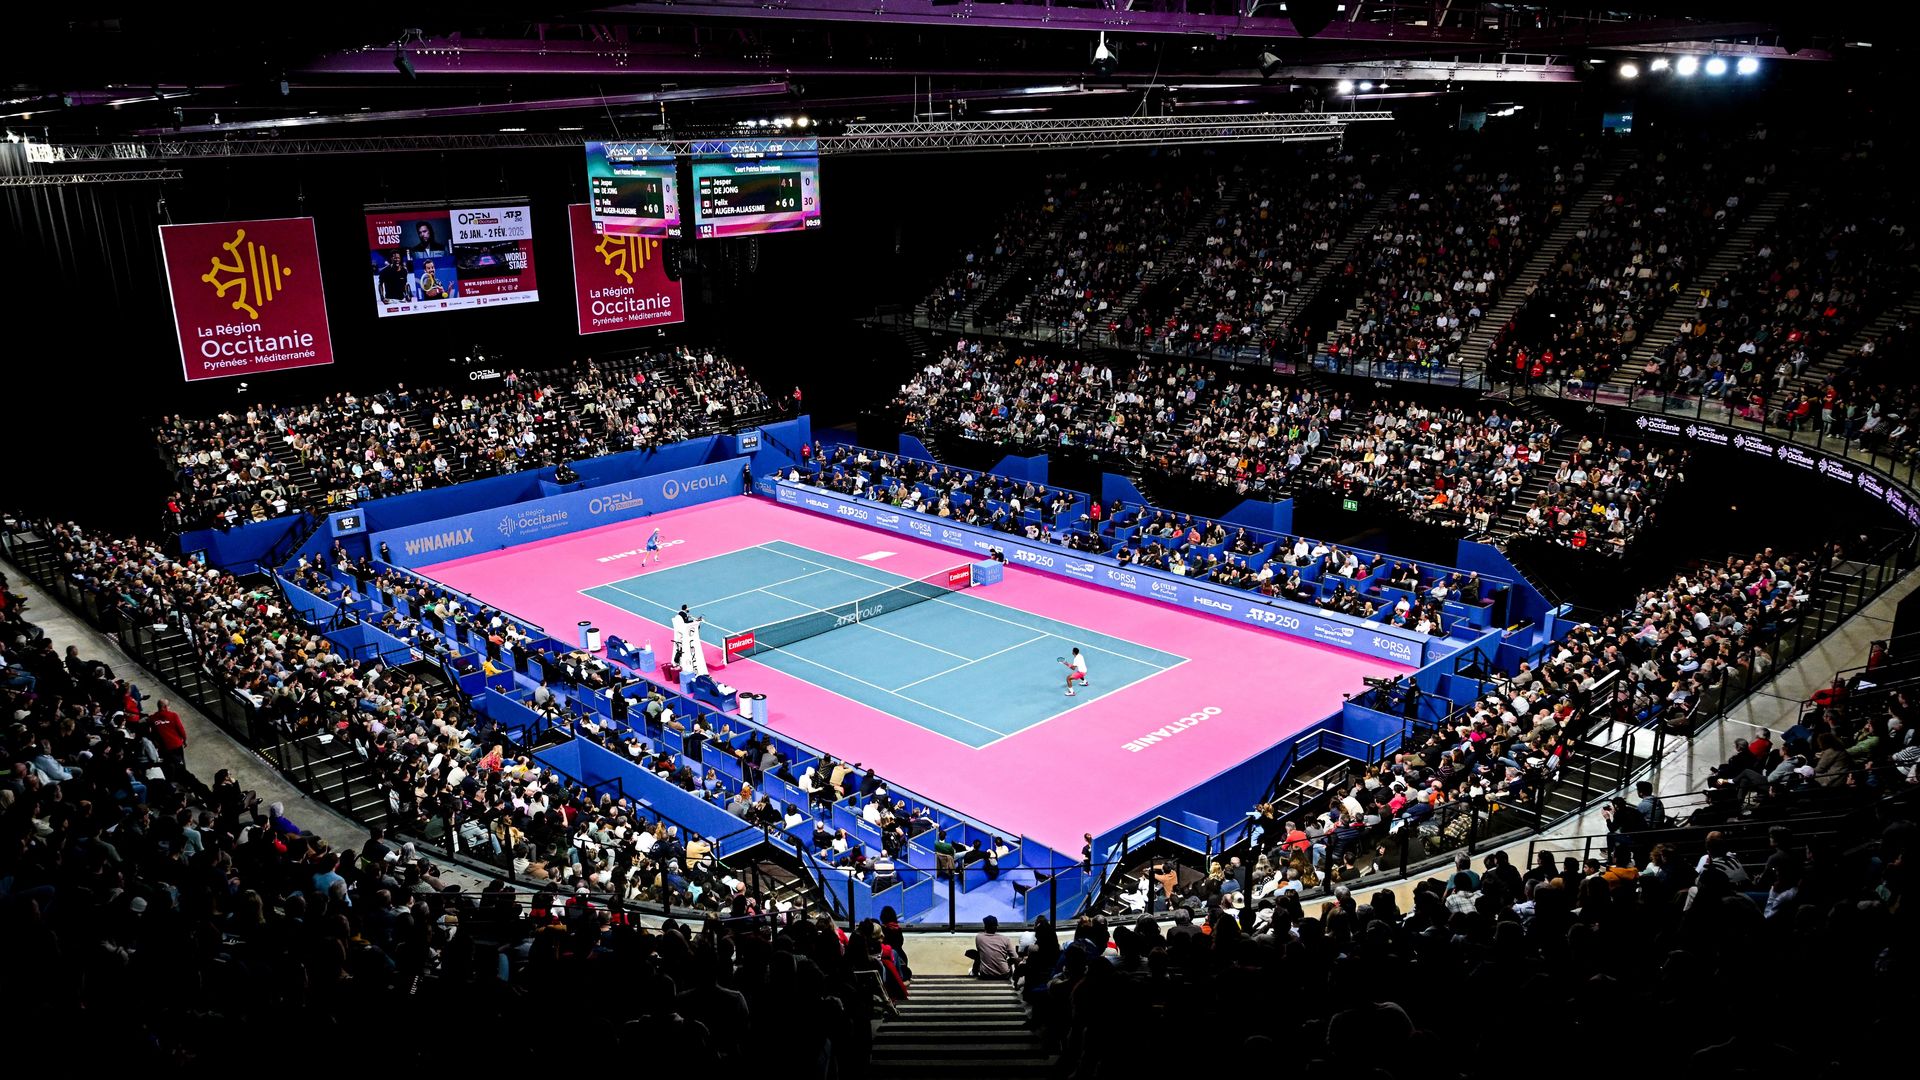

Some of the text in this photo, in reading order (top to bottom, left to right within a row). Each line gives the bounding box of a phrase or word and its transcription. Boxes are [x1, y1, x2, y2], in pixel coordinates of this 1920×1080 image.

[653, 184, 656, 192] 1
[788, 179, 793, 187] 1
[648, 204, 673, 213] 6 0 30
[782, 199, 787, 207] 6
[789, 198, 794, 206] 0
[715, 205, 766, 215] AUGER-ALIASSIME
[458, 212, 490, 225] OPEN
[377, 226, 402, 235] WORLD
[460, 231, 468, 239] 26
[470, 230, 483, 238] JAN.
[489, 229, 493, 237] 2
[494, 226, 507, 237] FÉV.
[508, 227, 524, 236] 2025
[378, 235, 400, 244] CLASS
[505, 252, 527, 261] WORLD
[509, 261, 528, 269] STAGE
[464, 278, 518, 286] www.openoccitanie.com
[590, 286, 634, 298] La Région
[592, 293, 671, 315] Occitanie
[593, 316, 623, 326] Pyrénées
[628, 310, 671, 321] Méditerranée
[198, 323, 261, 337] La Région
[201, 330, 313, 358] Occitanie
[204, 357, 247, 371] Pyrénées
[255, 350, 315, 364] Méditerranée
[470, 369, 494, 380] OPEN
[1649, 421, 1680, 431] Occitanie
[1698, 430, 1728, 441] Occitanie
[1745, 440, 1773, 452] Occitanie
[1787, 452, 1814, 465] Occitanie
[1828, 465, 1853, 479] Occitanie
[682, 474, 728, 492] VEOLIA
[589, 491, 632, 514] OPEN
[806, 498, 829, 508] HEAD
[342, 518, 354, 526] 182
[519, 510, 567, 528] Occitanie
[405, 528, 474, 556] WINAMAX
[974, 541, 1003, 553] HEAD
[950, 571, 969, 581] Emirates
[1193, 596, 1232, 611] HEAD
[857, 605, 883, 621] TOUR
[728, 637, 753, 650] Emirates
[1390, 652, 1411, 660] events
[1121, 706, 1222, 752] OCCITANIE
